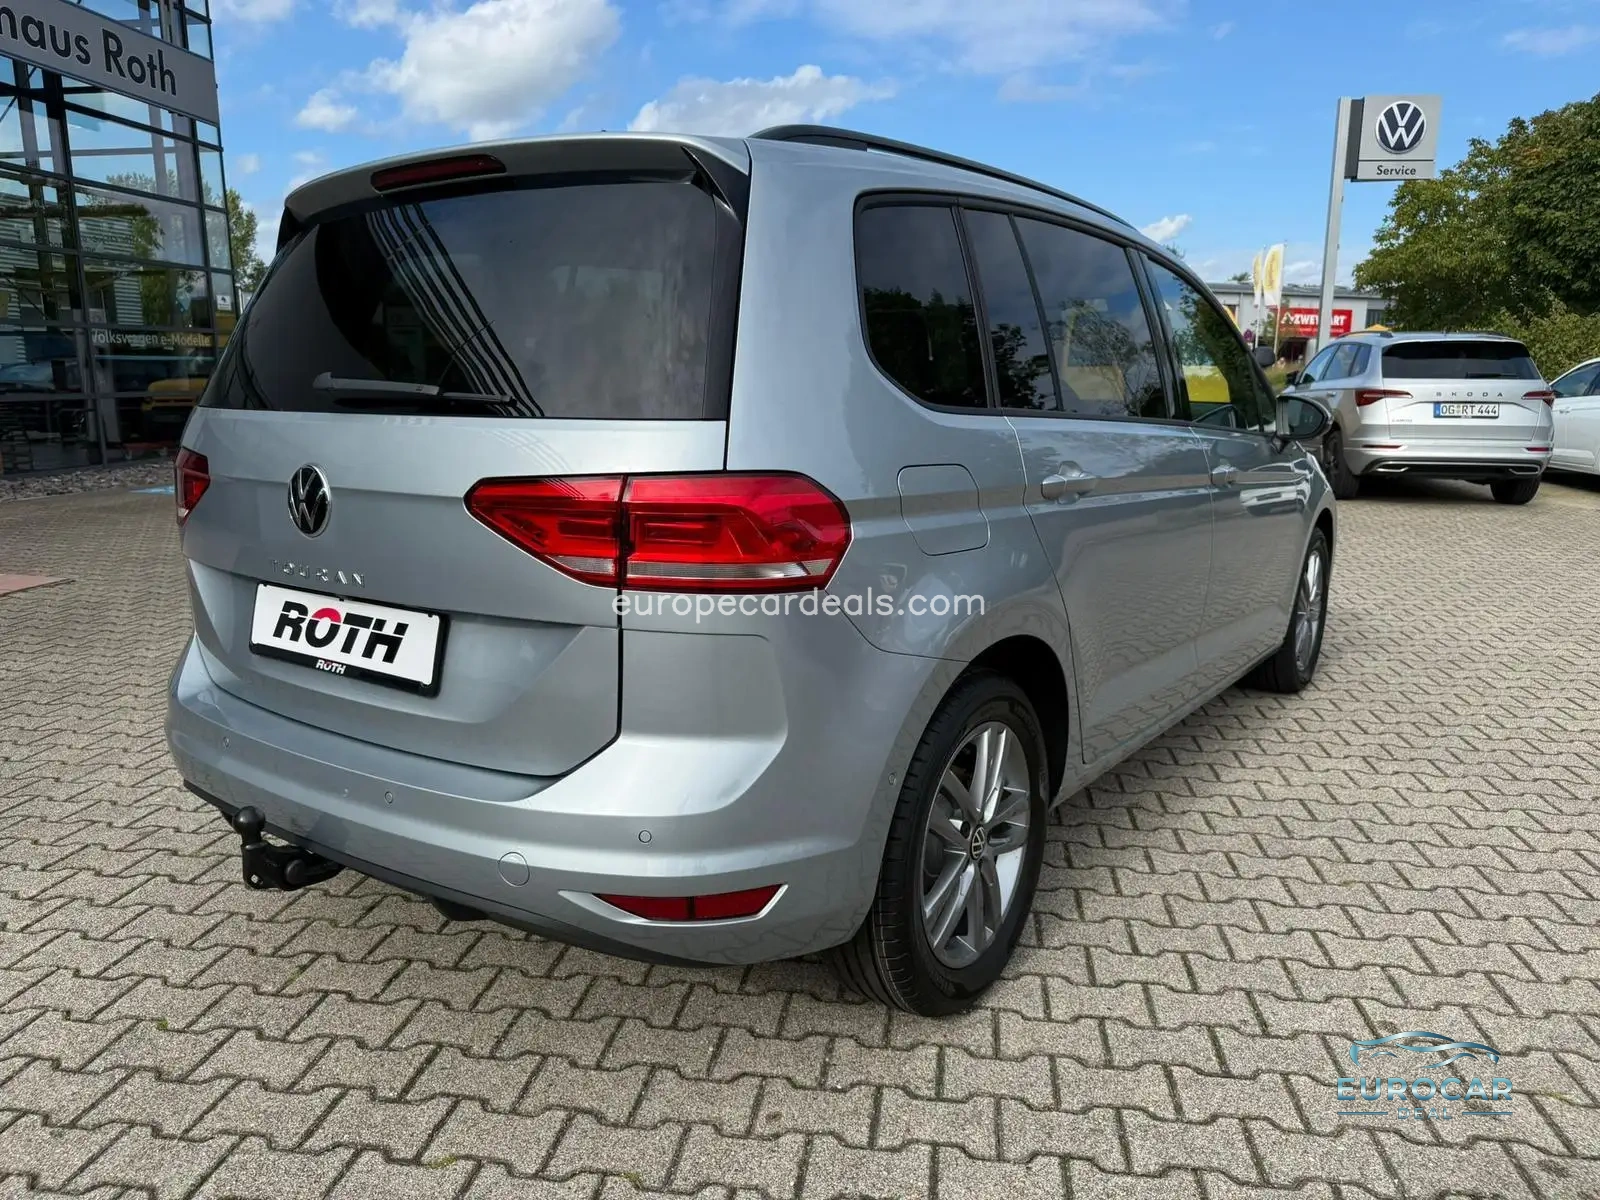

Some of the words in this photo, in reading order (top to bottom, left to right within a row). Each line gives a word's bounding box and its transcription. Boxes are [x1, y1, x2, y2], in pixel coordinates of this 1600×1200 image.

[102, 28, 177, 96] Roth
[1376, 165, 1417, 176] Service
[1294, 314, 1347, 326] ZWERT
[1441, 405, 1455, 415] OG
[1461, 405, 1476, 415] RT
[1477, 405, 1497, 415] 444
[270, 559, 366, 588] TOURAN
[272, 600, 409, 664] ROTH
[316, 659, 346, 675] ROTH
